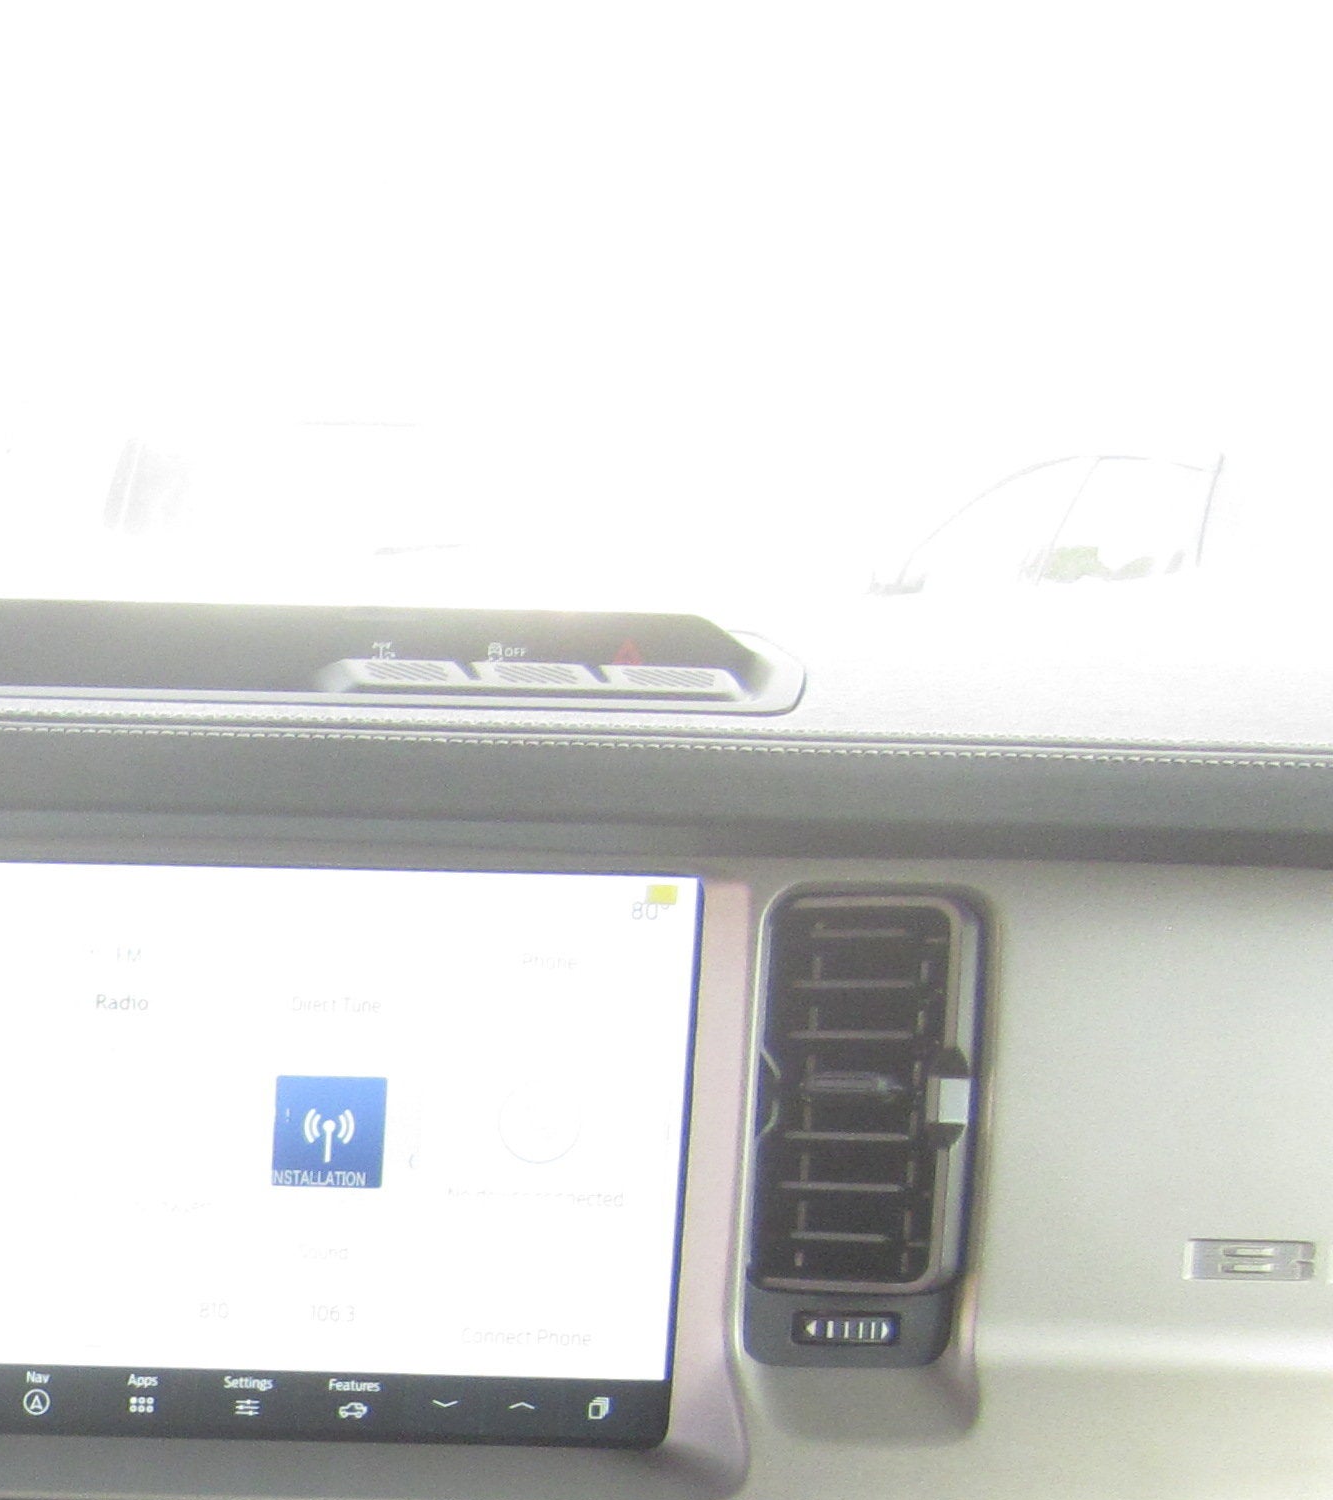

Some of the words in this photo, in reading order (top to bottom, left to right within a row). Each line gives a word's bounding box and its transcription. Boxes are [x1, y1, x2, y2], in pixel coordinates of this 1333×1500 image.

[504, 647, 527, 657] OFF
[95, 993, 150, 1012] Radio
[26, 1370, 51, 1384] Nav
[128, 1373, 159, 1388] Apps
[223, 1375, 274, 1391] Settings
[328, 1378, 381, 1393] Features
